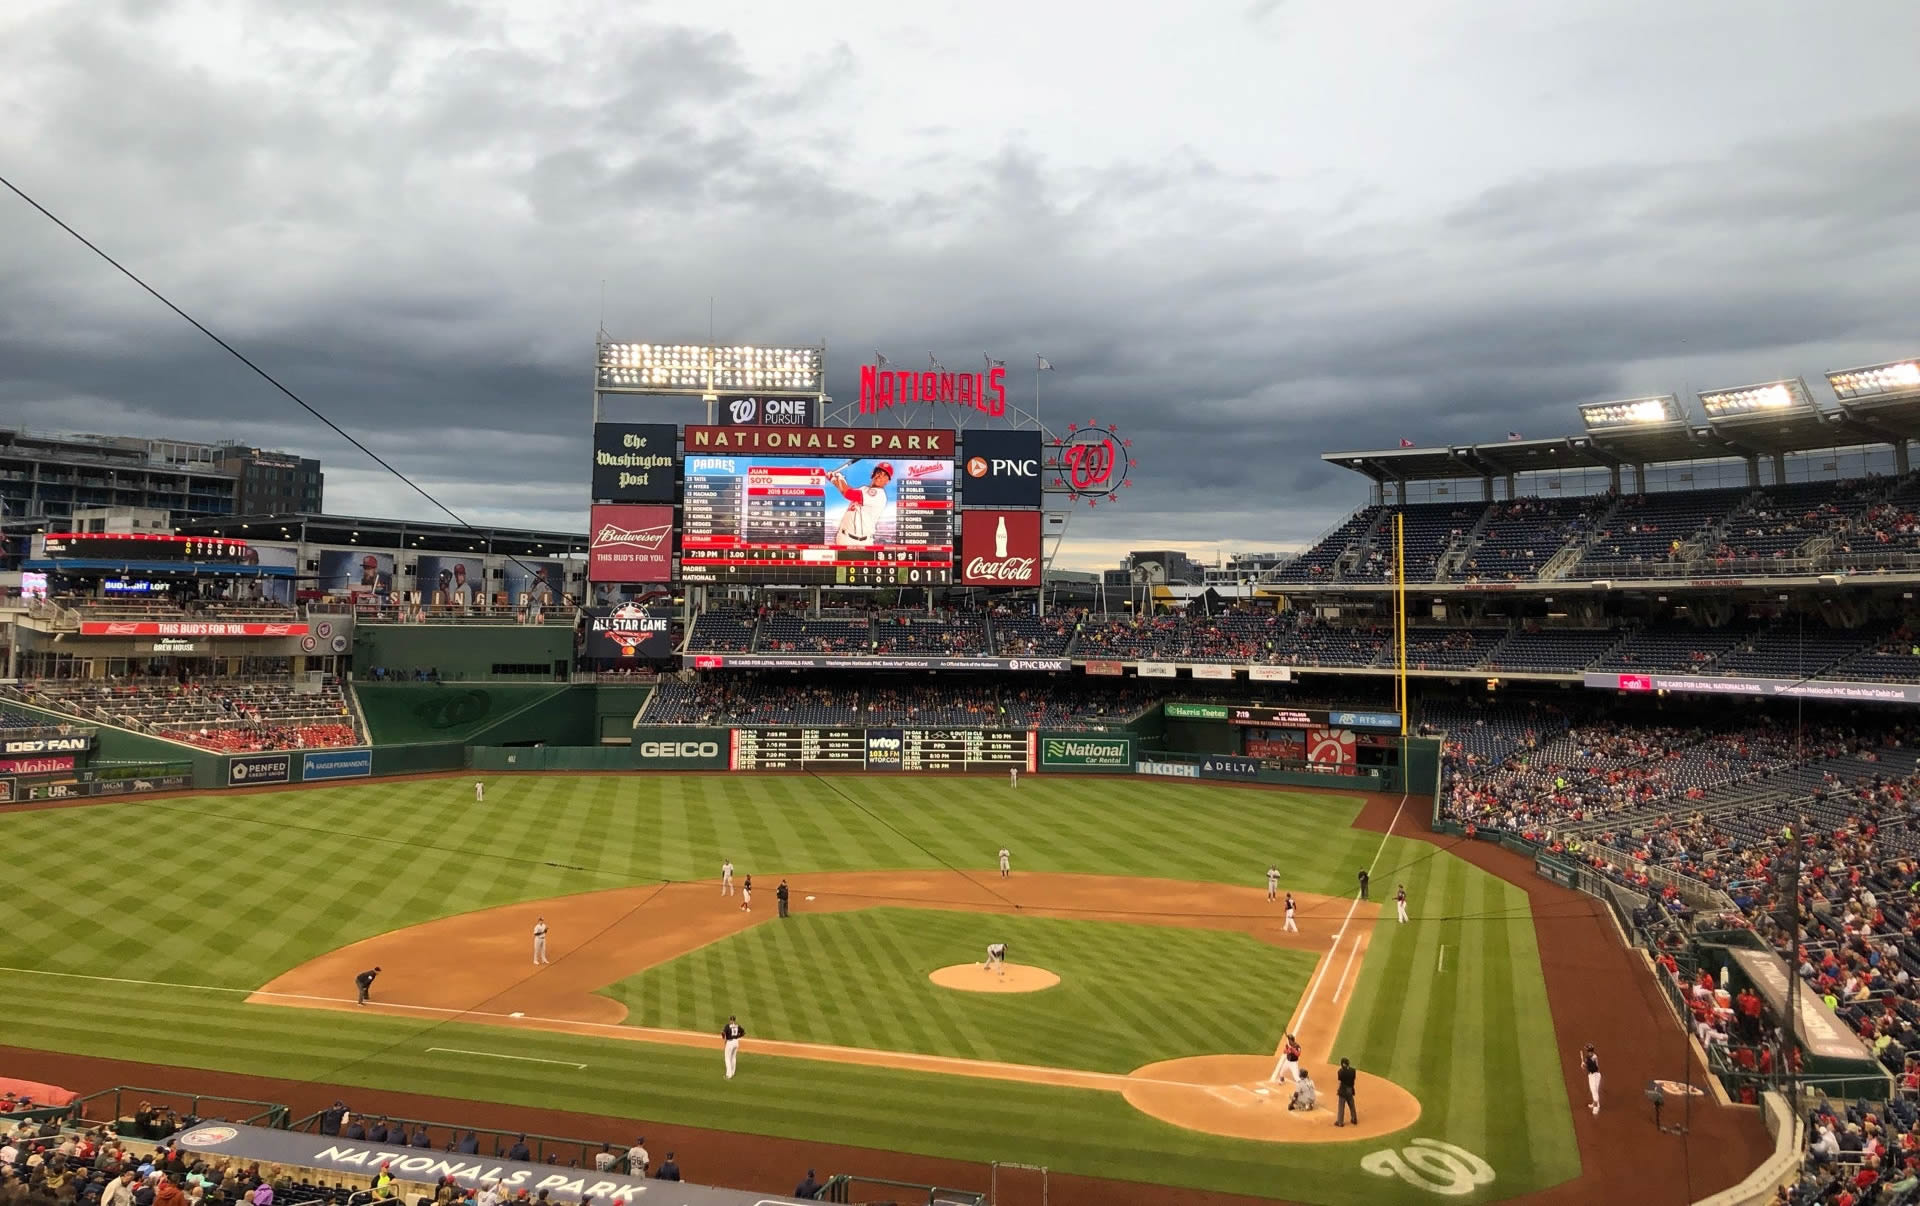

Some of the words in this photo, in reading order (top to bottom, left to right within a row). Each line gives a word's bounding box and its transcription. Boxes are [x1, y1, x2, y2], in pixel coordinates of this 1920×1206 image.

[859, 364, 1006, 417] NATIONALS
[765, 400, 806, 414] ONE
[765, 414, 805, 425] PURSUIT
[623, 434, 647, 448] The
[694, 431, 856, 448] NATIONALS
[871, 435, 940, 450] PARK
[596, 449, 672, 469] Washington
[693, 458, 735, 473] PADRES
[908, 462, 944, 477] Nationals
[991, 459, 1038, 476] PNC
[618, 471, 649, 488] Post
[599, 529, 663, 543] Budweiser
[597, 553, 612, 561] THIS
[613, 553, 633, 562] BUD'S
[635, 553, 648, 562] FOR
[649, 553, 665, 562] YOU.
[966, 556, 1037, 580] Coca-Cola
[849, 575, 855, 583] 0
[910, 570, 920, 581] 0
[926, 570, 931, 581] 1
[940, 570, 946, 581] 1
[150, 583, 170, 591] LOFT
[159, 624, 179, 633] THIS
[181, 624, 206, 633] BUD'S
[208, 624, 225, 634] FOR
[226, 624, 246, 634] YOU.
[640, 619, 667, 631] GAME
[153, 643, 171, 651] BREW
[172, 643, 194, 652] HOUSE
[1019, 661, 1038, 669] PNC
[1039, 661, 1062, 669] BANK
[1176, 707, 1200, 716] Harris
[1201, 709, 1226, 718] Teeter
[47, 738, 85, 750] FAN
[640, 742, 718, 757] GEICO
[869, 737, 900, 749] wtop
[1065, 743, 1123, 757] National
[248, 763, 286, 772] PENFED
[1151, 763, 1195, 776] KOCH
[1216, 761, 1256, 773] DELTA
[101, 782, 124, 791] MGM
[162, 777, 183, 785] MGM
[313, 1145, 532, 1185] NATIONALS
[535, 1174, 647, 1201] PARK
